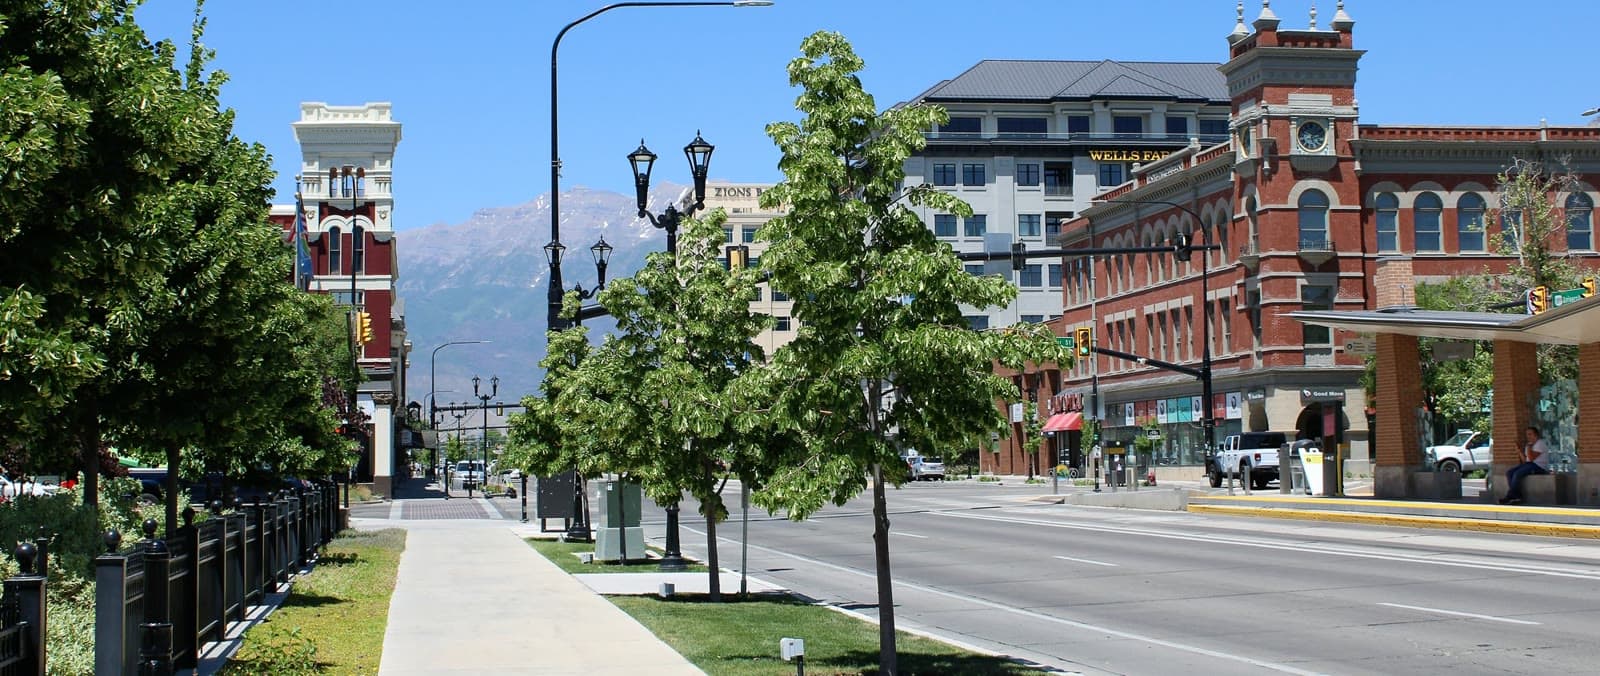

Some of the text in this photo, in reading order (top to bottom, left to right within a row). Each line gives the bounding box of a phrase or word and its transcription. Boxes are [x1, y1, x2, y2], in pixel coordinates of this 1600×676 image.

[1089, 150, 1170, 161] WELLS FAR
[714, 187, 763, 197] ZIONS B
